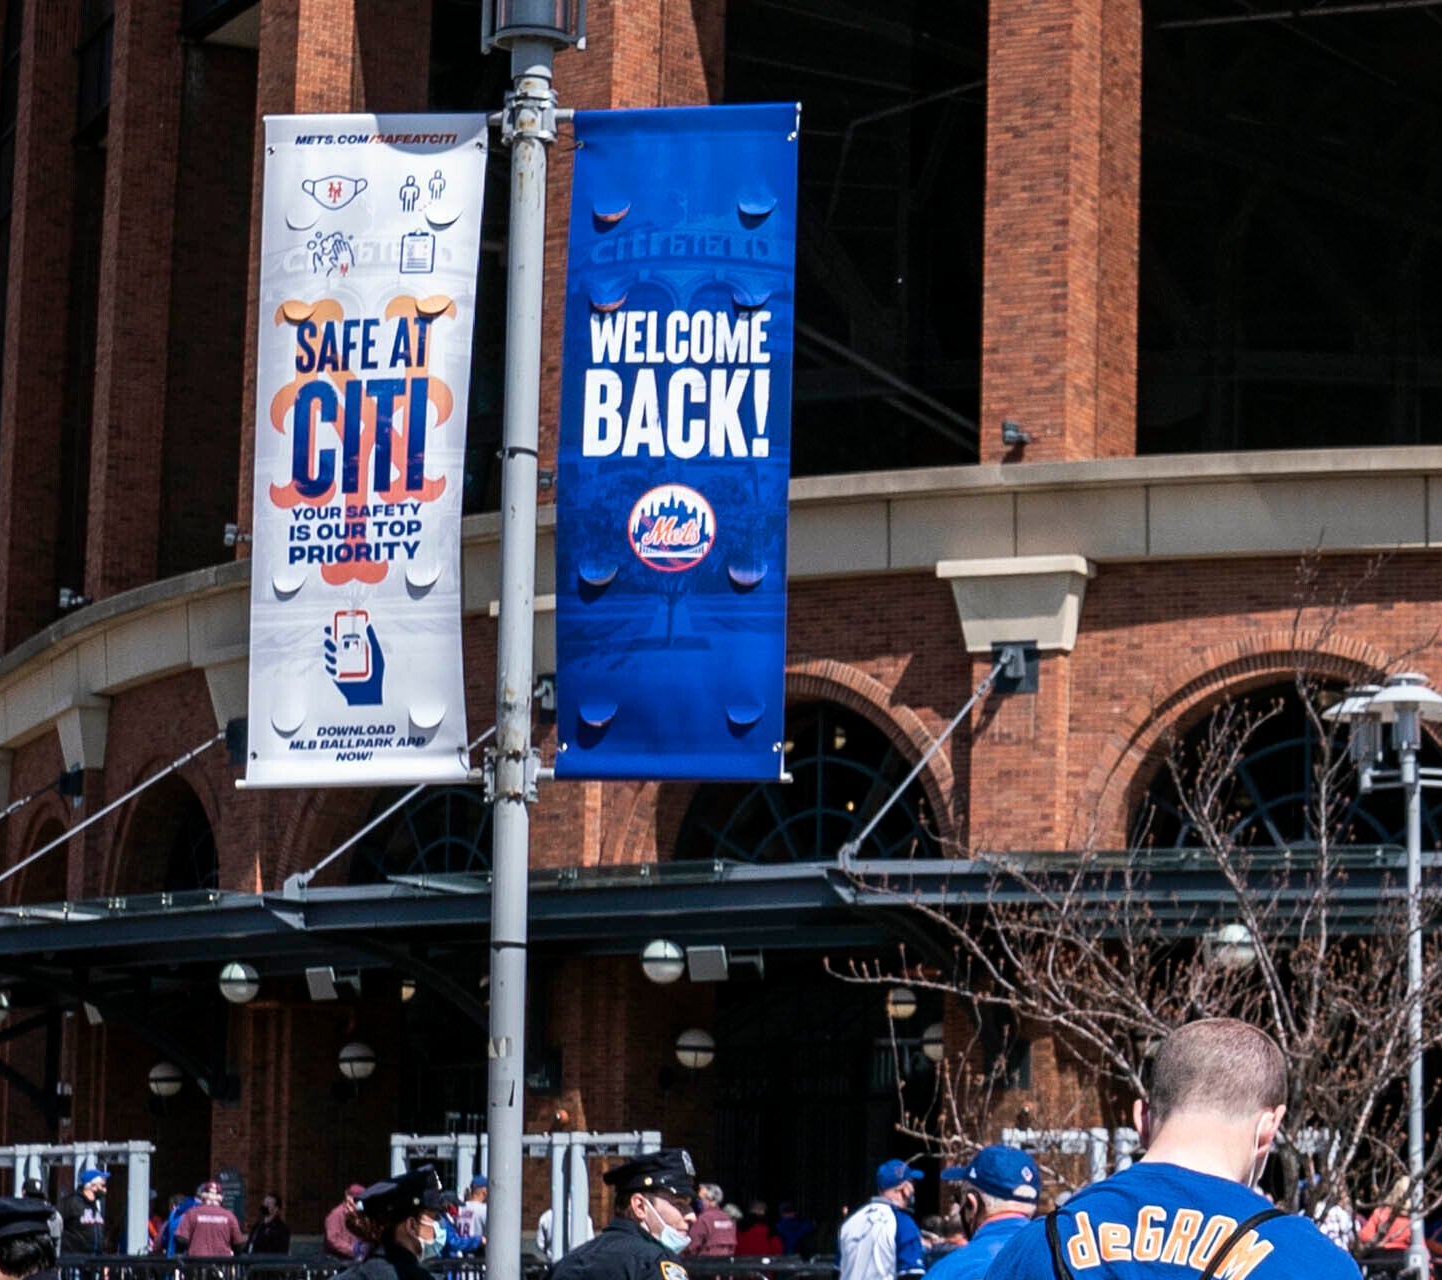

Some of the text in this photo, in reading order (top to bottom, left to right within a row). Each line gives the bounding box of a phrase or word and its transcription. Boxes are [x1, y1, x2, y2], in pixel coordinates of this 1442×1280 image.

[295, 133, 458, 146] METS.COM/SAFEATCITI
[295, 316, 432, 374] SAFE AT
[590, 310, 771, 364] WELCOME
[582, 368, 771, 459] BACK!
[292, 377, 429, 499] CITI
[292, 503, 422, 521] YOUR SAFETY
[289, 519, 422, 542] IS OUR TOP
[642, 515, 701, 547] Mets
[289, 540, 421, 565] PRIORITY
[316, 725, 396, 737] DOWNLOAD
[289, 736, 426, 751] MLB BALLPARK APP
[335, 751, 374, 762] NOW!
